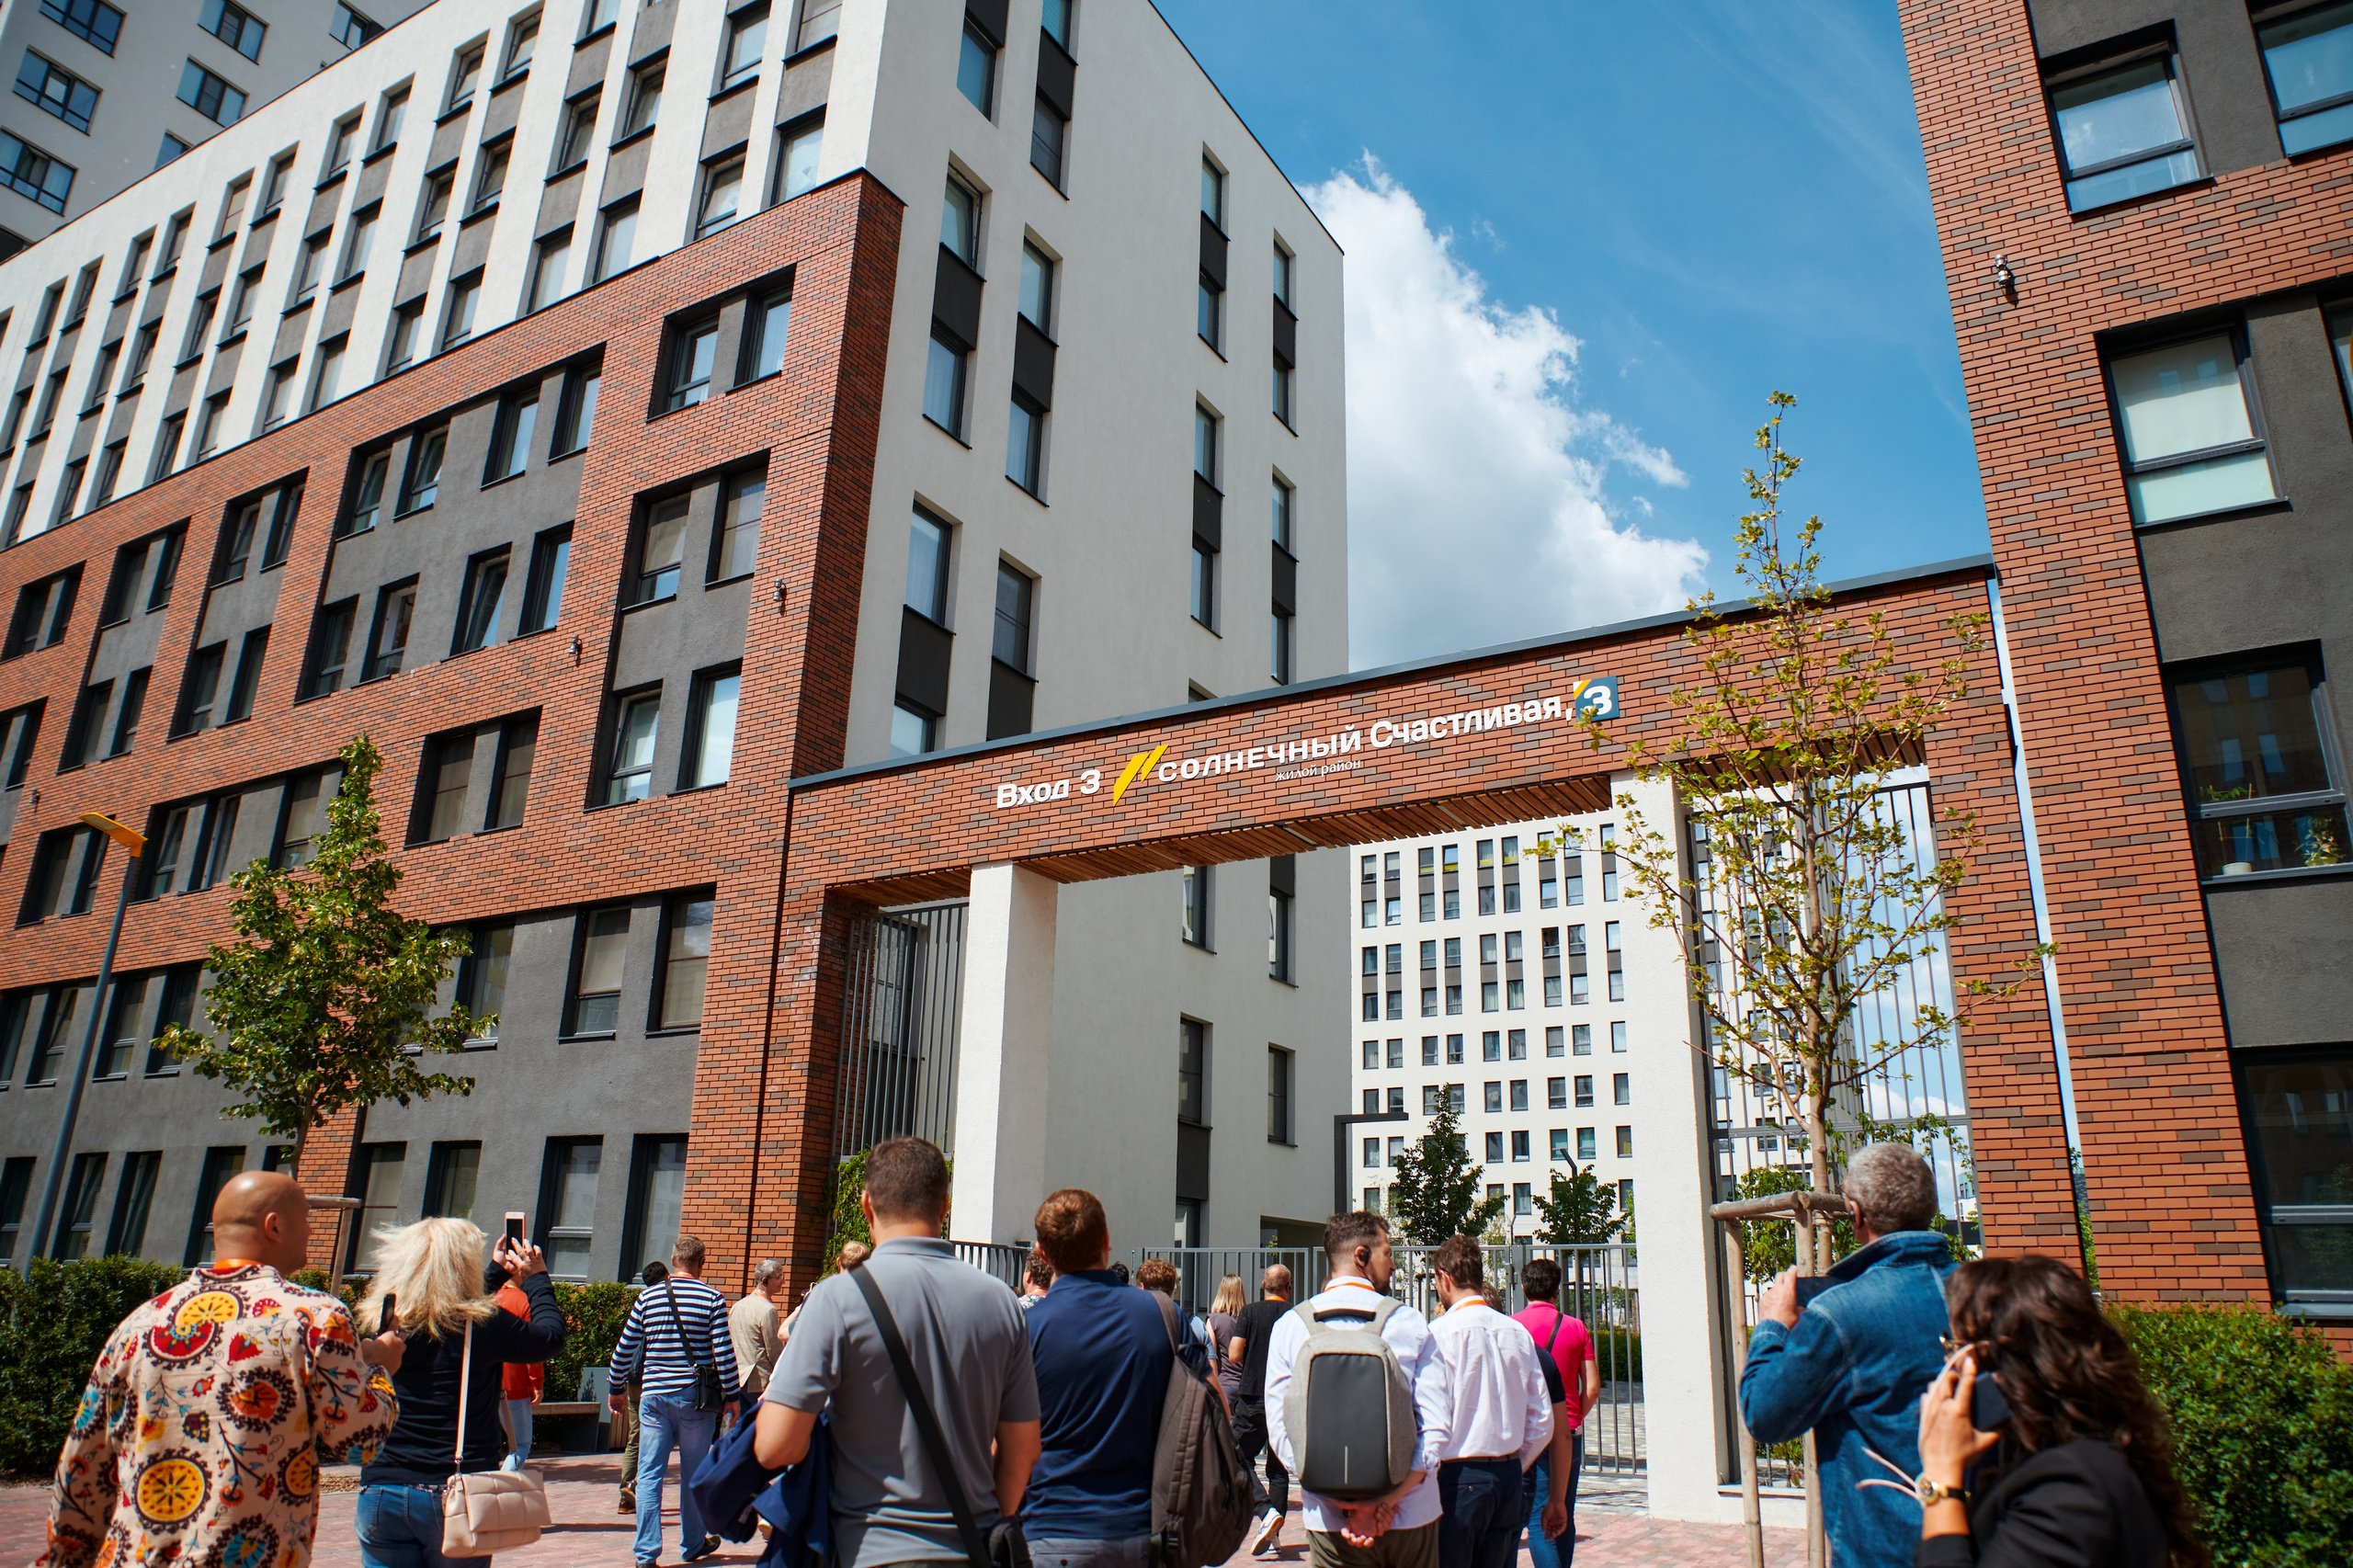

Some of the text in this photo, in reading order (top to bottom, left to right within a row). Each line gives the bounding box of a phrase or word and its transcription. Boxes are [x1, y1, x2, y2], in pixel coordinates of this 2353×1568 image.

[996, 779, 1070, 809] Вход
[1079, 769, 1101, 795] 3
[1370, 696, 1573, 749] Счастливая,
[1583, 685, 1612, 716] 3
[1275, 759, 1361, 782] жилой район
